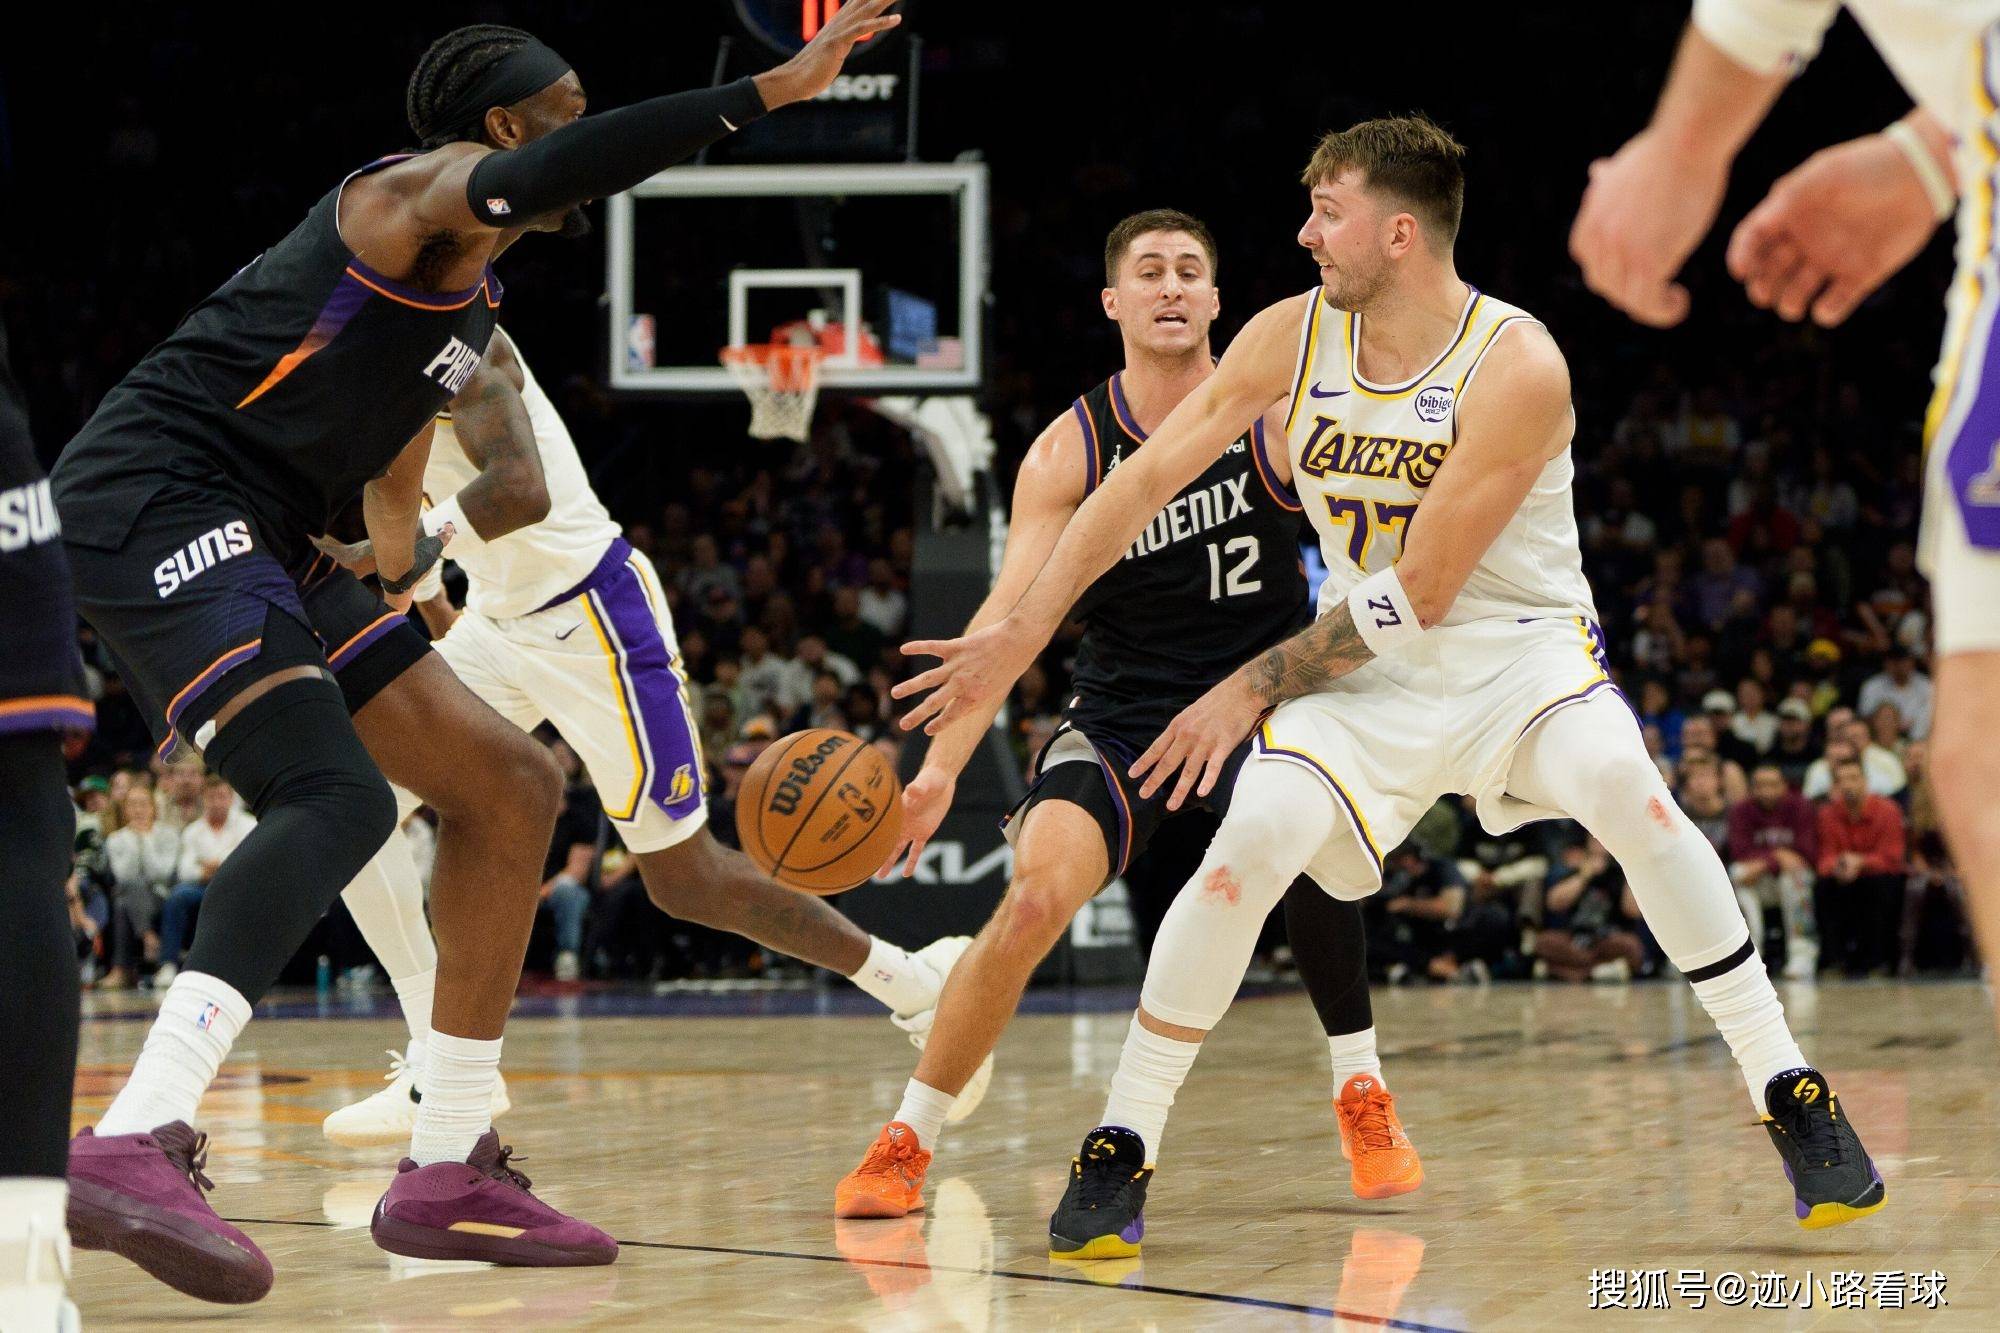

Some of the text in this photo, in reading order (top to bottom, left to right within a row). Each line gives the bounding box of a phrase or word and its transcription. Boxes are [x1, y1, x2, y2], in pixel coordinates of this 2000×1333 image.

[1299, 415, 1450, 490] LAKERS
[153, 520, 253, 598] SUNS
[1206, 535, 1262, 600] 12
[1367, 594, 1402, 629] 77
[769, 735, 850, 816] Wilson
